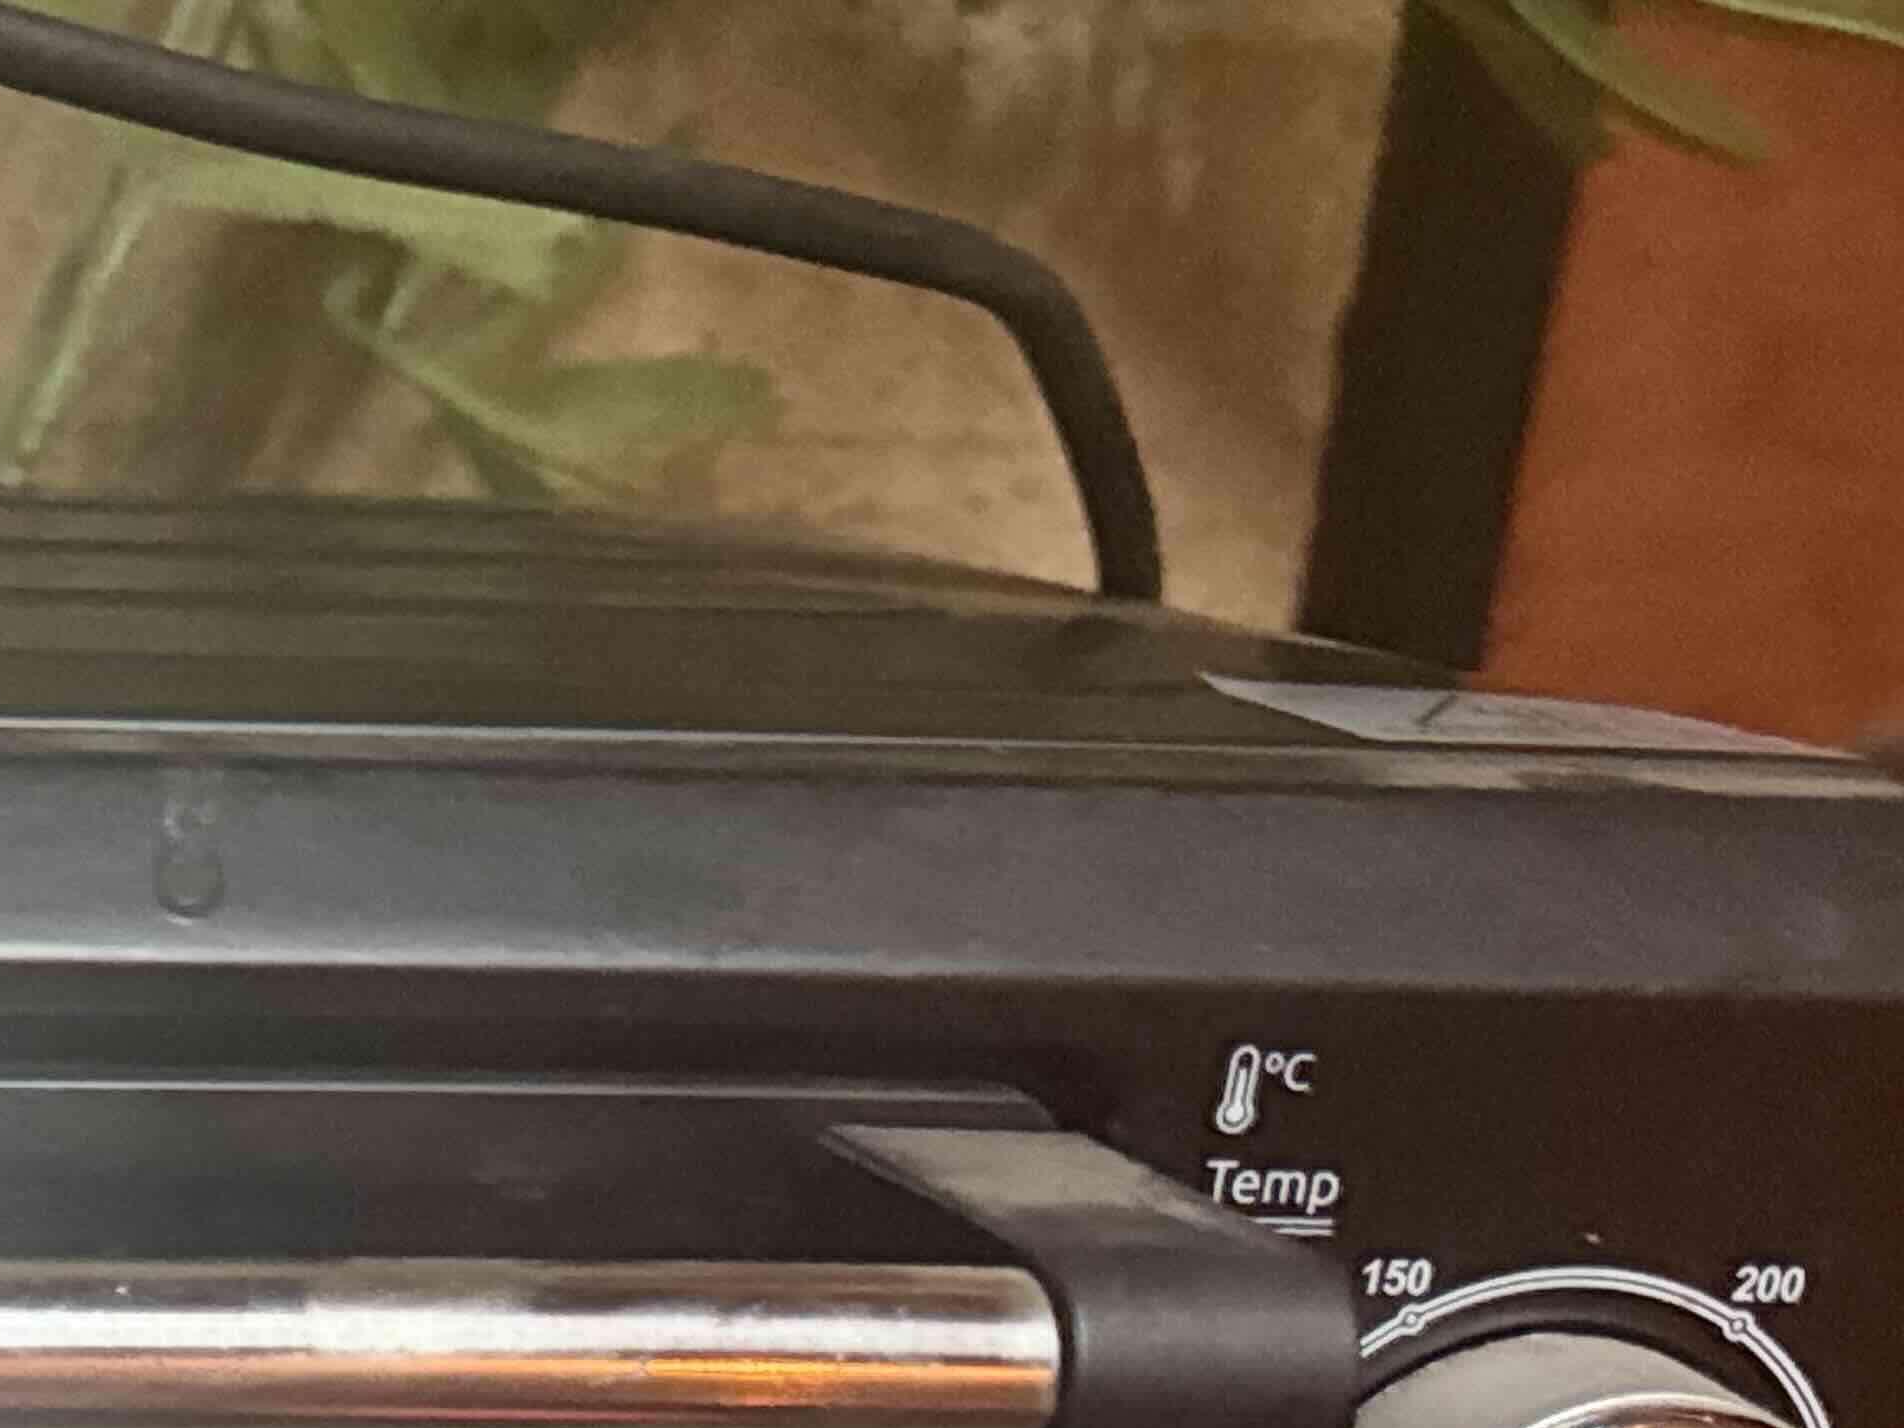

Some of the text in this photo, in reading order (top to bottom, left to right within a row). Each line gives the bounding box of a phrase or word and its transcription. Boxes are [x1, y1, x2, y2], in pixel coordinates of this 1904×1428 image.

[1206, 1158, 1342, 1211] Temp
[1362, 1257, 1433, 1298] 150
[1731, 1265, 1806, 1304] 200
